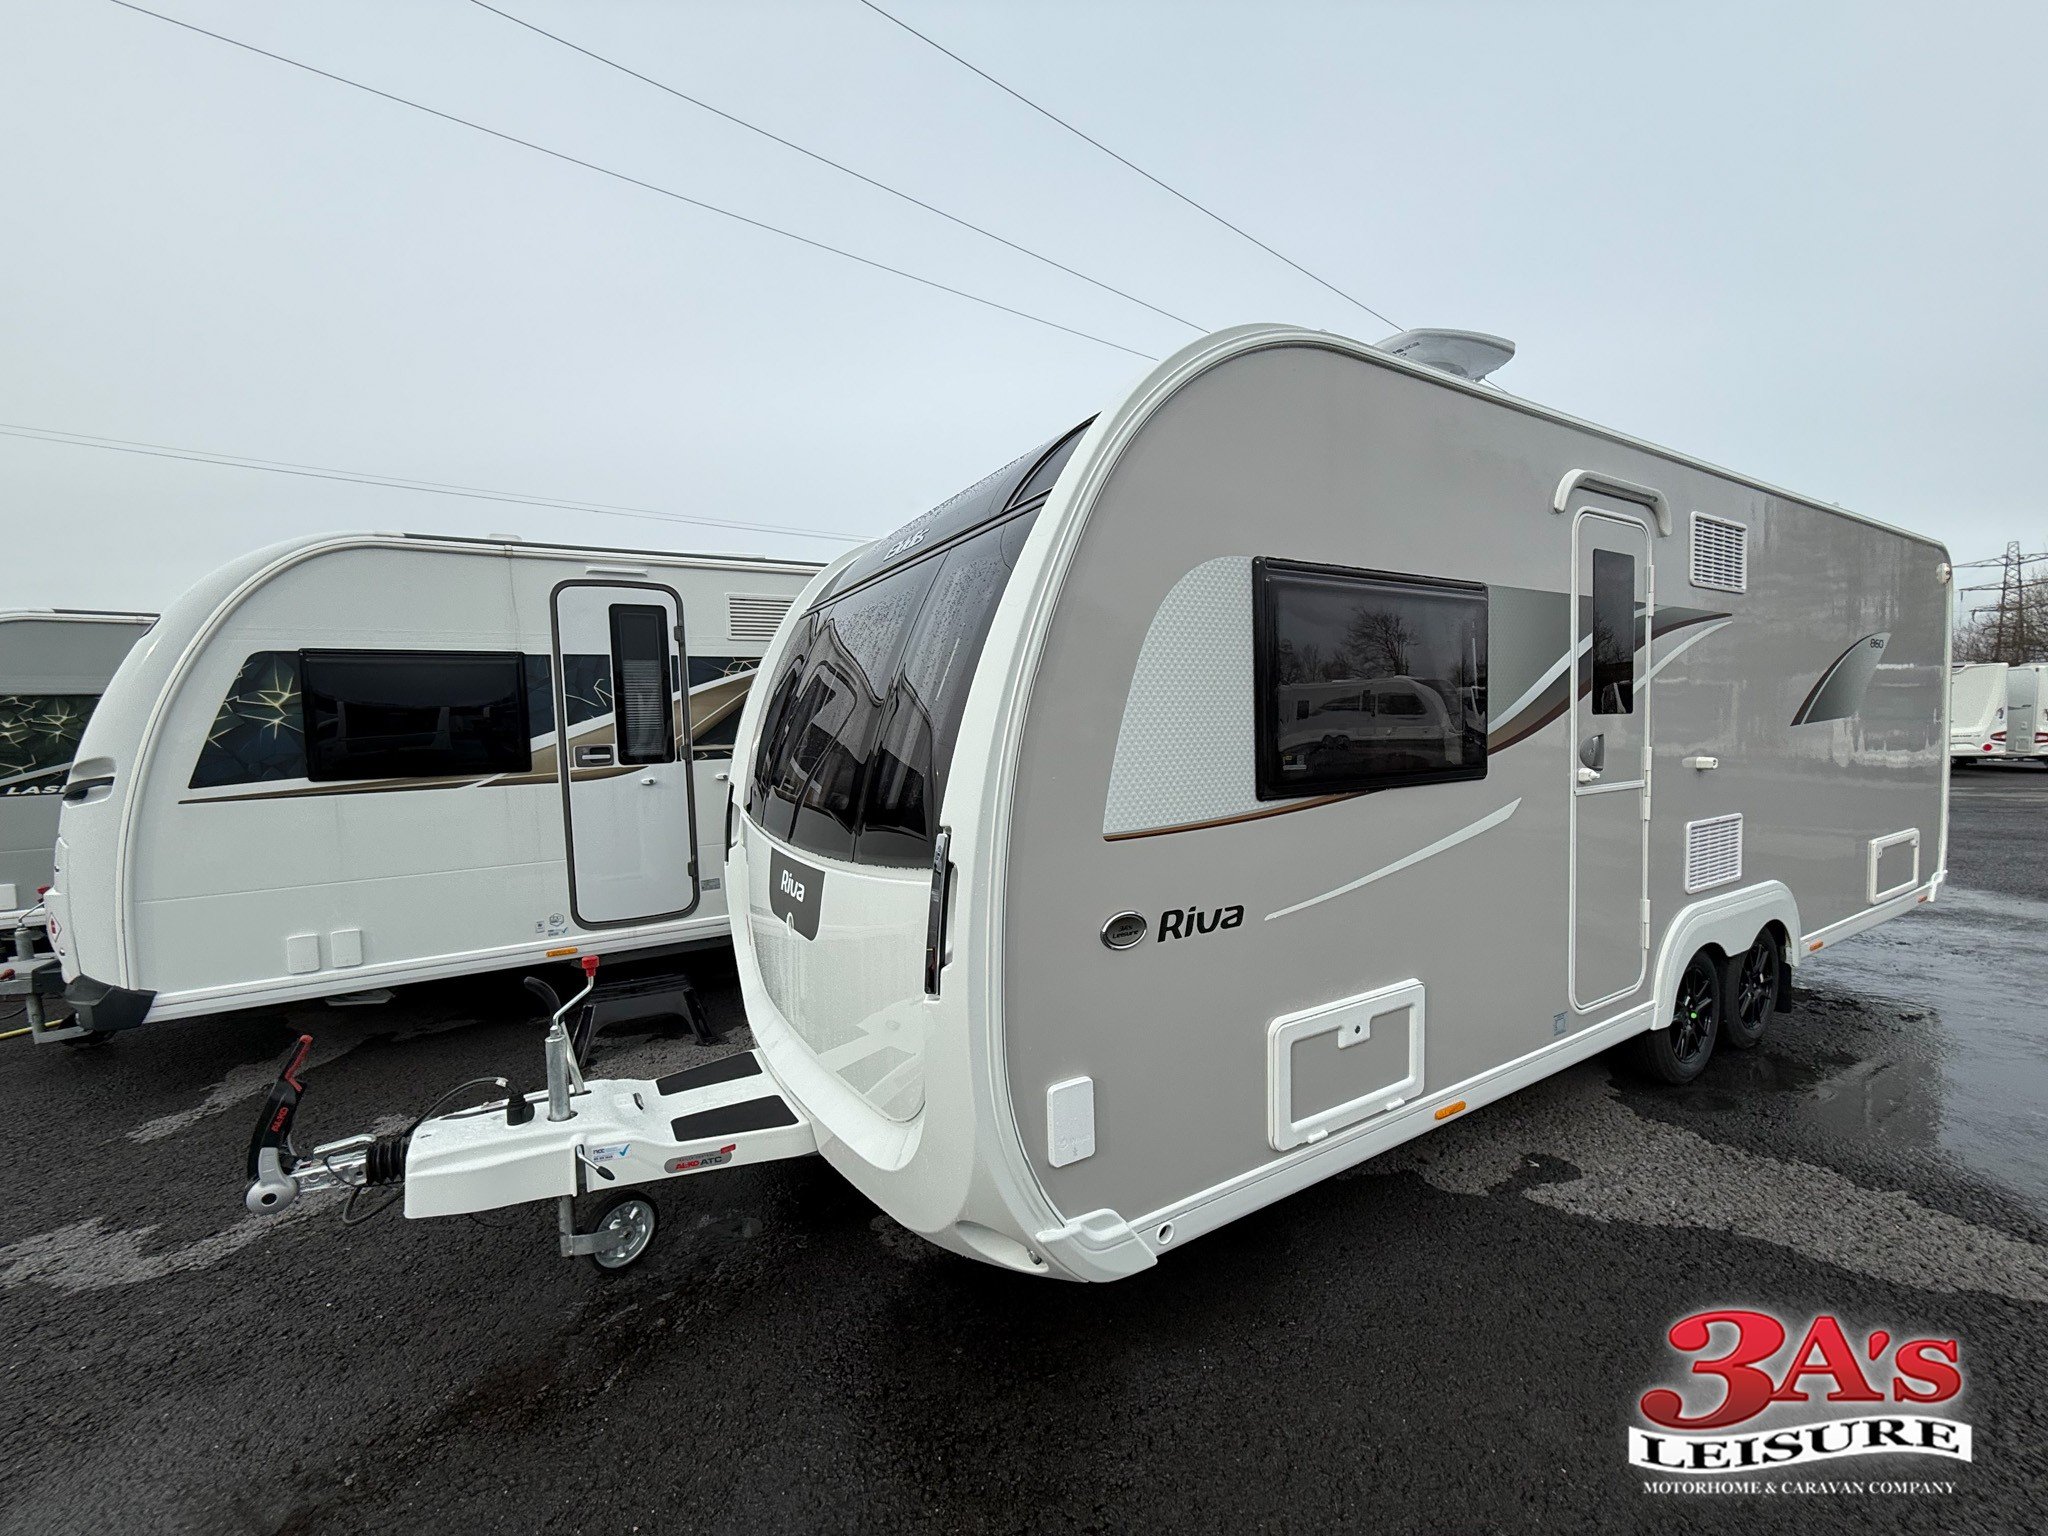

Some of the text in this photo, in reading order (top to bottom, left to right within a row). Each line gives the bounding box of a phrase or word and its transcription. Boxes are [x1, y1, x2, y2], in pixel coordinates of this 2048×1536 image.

[780, 869, 805, 903] Riva
[1157, 904, 1245, 943] Riva
[700, 1156, 722, 1166] ATC
